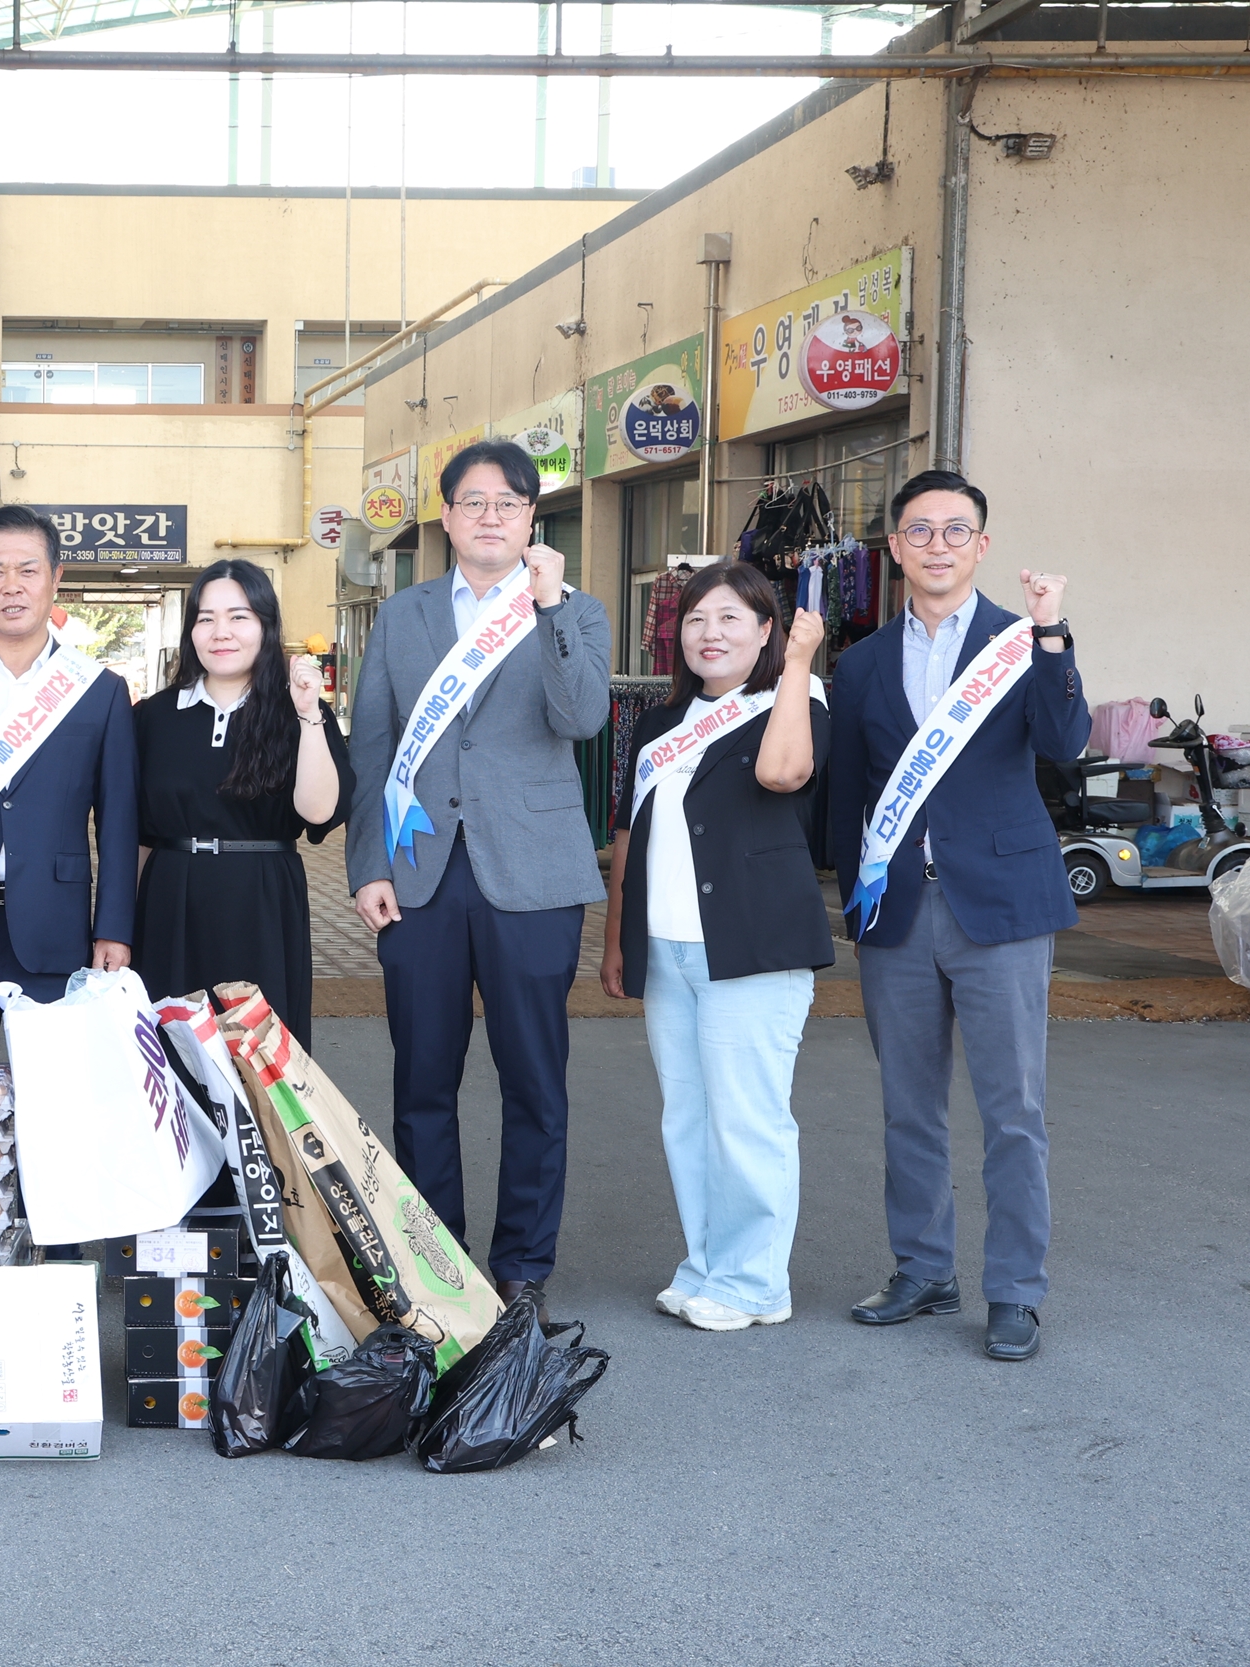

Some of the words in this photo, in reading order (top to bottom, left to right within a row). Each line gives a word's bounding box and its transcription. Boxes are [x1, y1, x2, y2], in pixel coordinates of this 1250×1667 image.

[859, 266, 891, 307] 남성복
[220, 341, 228, 403] 신태인시장
[816, 358, 891, 383] 우영패션
[827, 390, 878, 400] 011-403-9759
[633, 419, 692, 441] 은덕상회
[644, 446, 682, 455] 571-6517
[367, 498, 402, 519] 찻집
[50, 511, 173, 546] 방앗간
[320, 510, 343, 543] 국수
[395, 674, 467, 789] 이용합시다
[638, 699, 742, 783] 전통시장을
[875, 728, 955, 844] 이용합시다
[330, 1180, 385, 1268] 상상플러스
[72, 1302, 85, 1323] 서로
[77, 1356, 86, 1372] 있는
[29, 1441, 88, 1449] 친환경버섯
